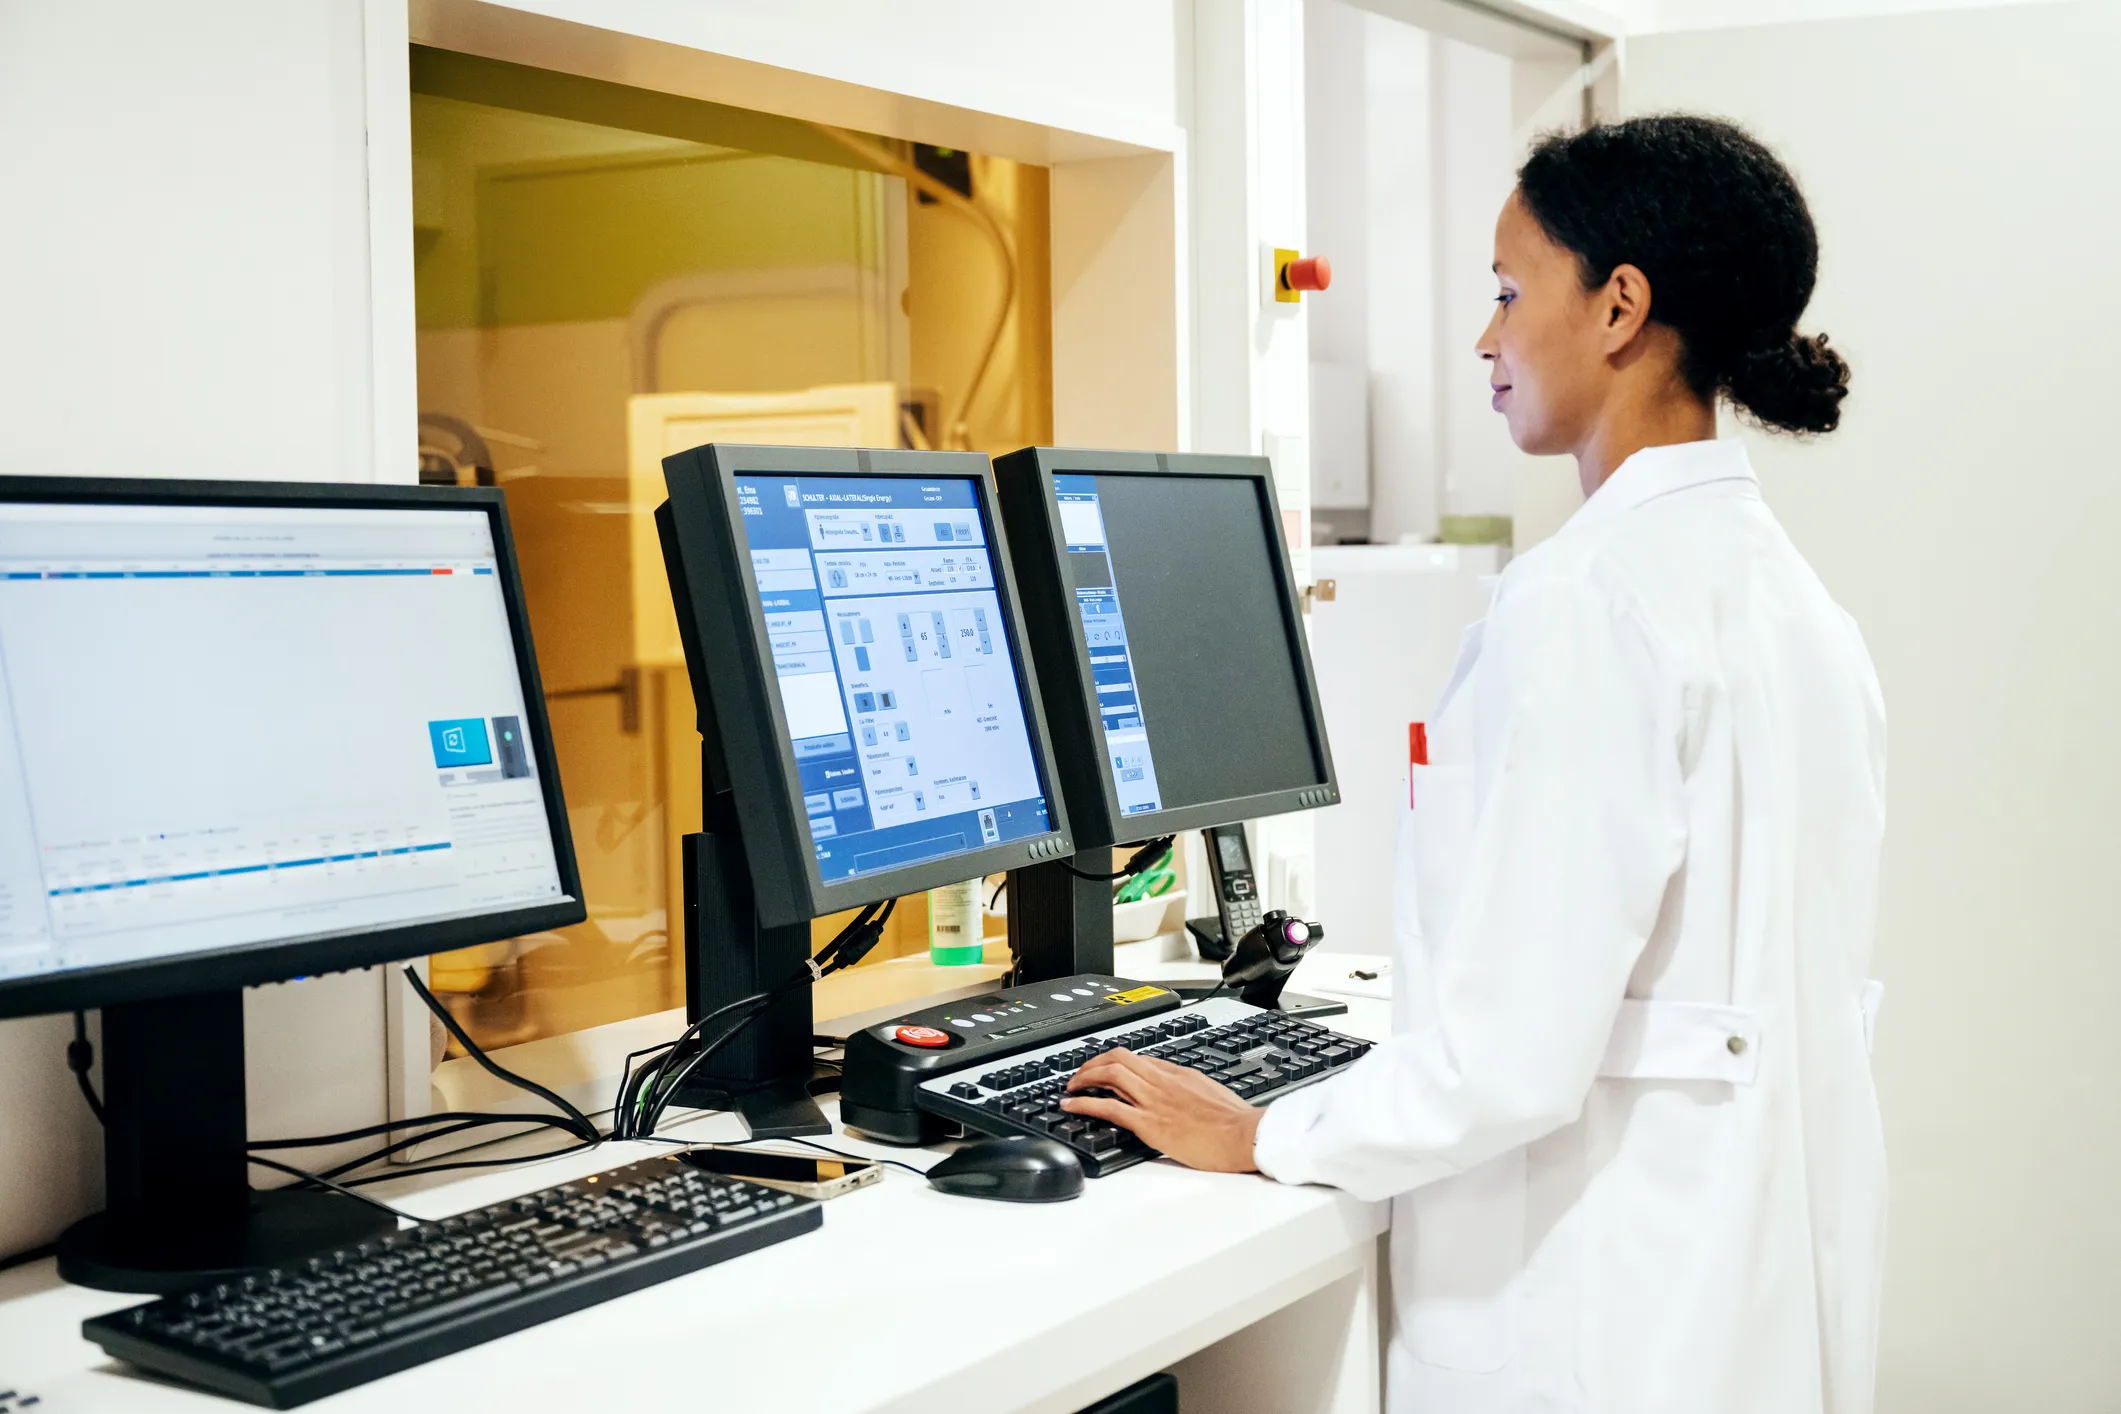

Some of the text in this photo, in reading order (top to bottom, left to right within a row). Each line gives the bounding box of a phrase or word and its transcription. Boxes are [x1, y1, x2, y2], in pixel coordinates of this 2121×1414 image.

[802, 494, 825, 502] SCHULTER
[920, 631, 928, 641] 65
[960, 628, 975, 638] 250.0
